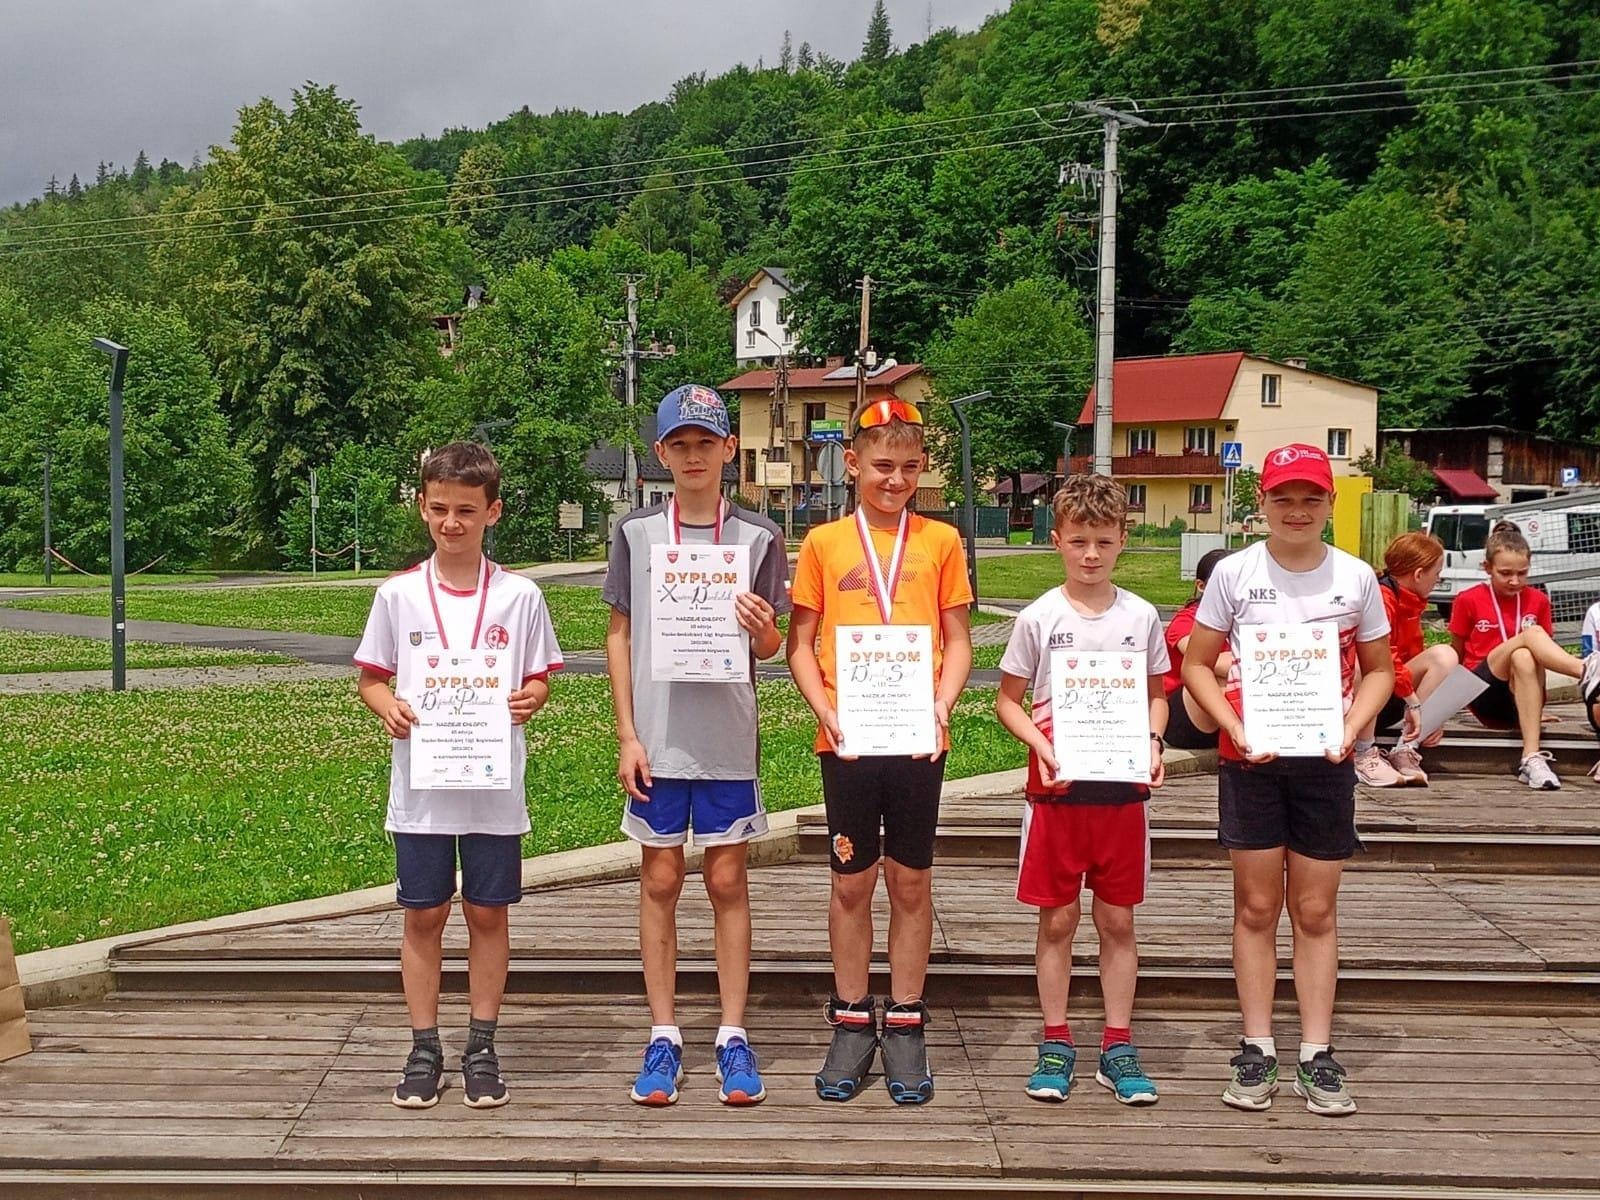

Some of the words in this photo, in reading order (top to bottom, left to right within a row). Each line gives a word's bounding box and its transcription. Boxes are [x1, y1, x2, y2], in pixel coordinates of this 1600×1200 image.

[664, 572, 737, 584] DYPLOM
[1249, 588, 1277, 600] NKS
[1049, 632, 1074, 645] NKS
[850, 652, 920, 663] DYPLOM
[1254, 649, 1327, 661] DYPLOM
[424, 677, 499, 689] DYPLOM
[1065, 677, 1136, 689] DYPLOM
